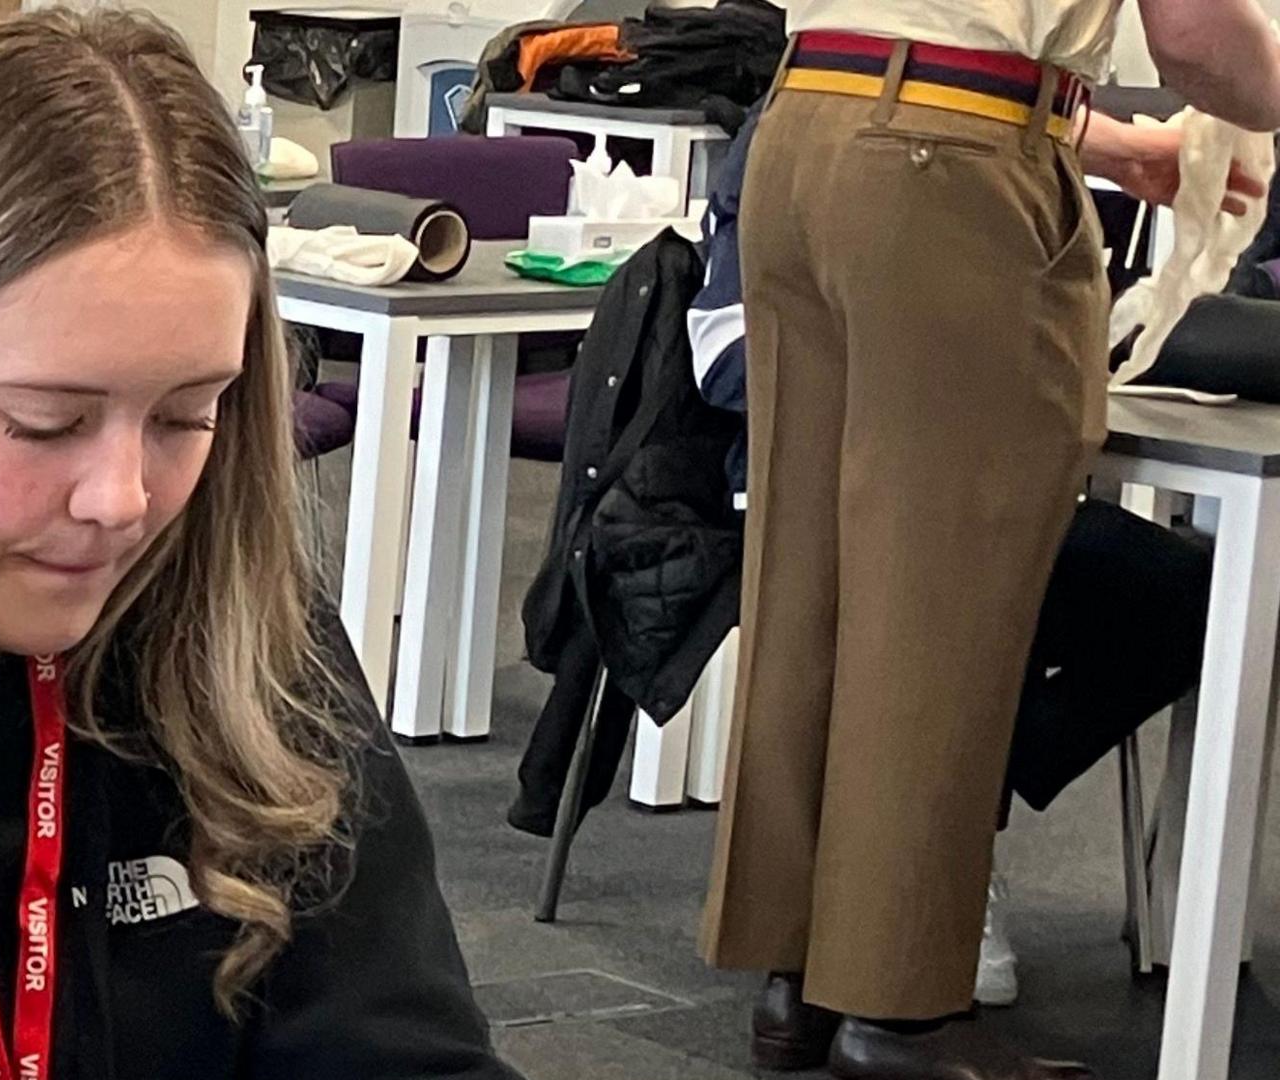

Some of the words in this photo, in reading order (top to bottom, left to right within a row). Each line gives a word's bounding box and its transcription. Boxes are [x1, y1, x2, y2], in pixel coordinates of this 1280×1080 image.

[37, 742, 60, 839] VISITOR
[26, 897, 48, 992] VISITOR
[105, 898, 158, 926] ACE
